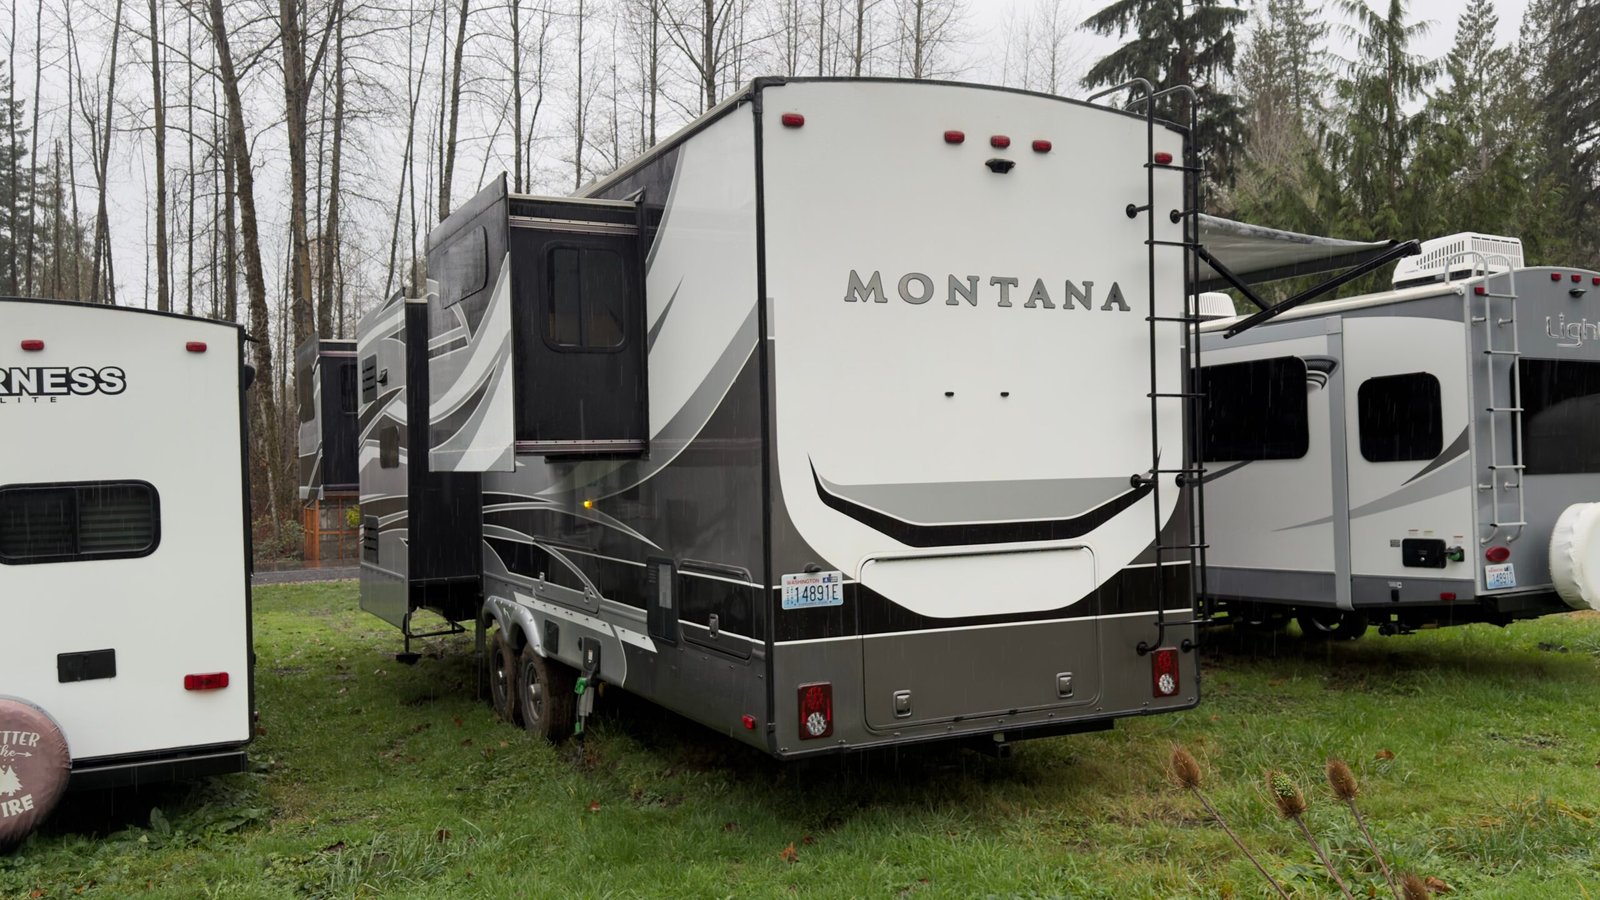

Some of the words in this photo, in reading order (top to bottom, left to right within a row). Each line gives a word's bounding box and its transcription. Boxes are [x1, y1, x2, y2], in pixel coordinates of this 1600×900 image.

[844, 269, 1131, 312] MONTANA
[1545, 312, 1600, 348] Ligh
[795, 583, 839, 603] 14891E
[0, 744, 17, 758] he
[1, 793, 34, 818] IRE
